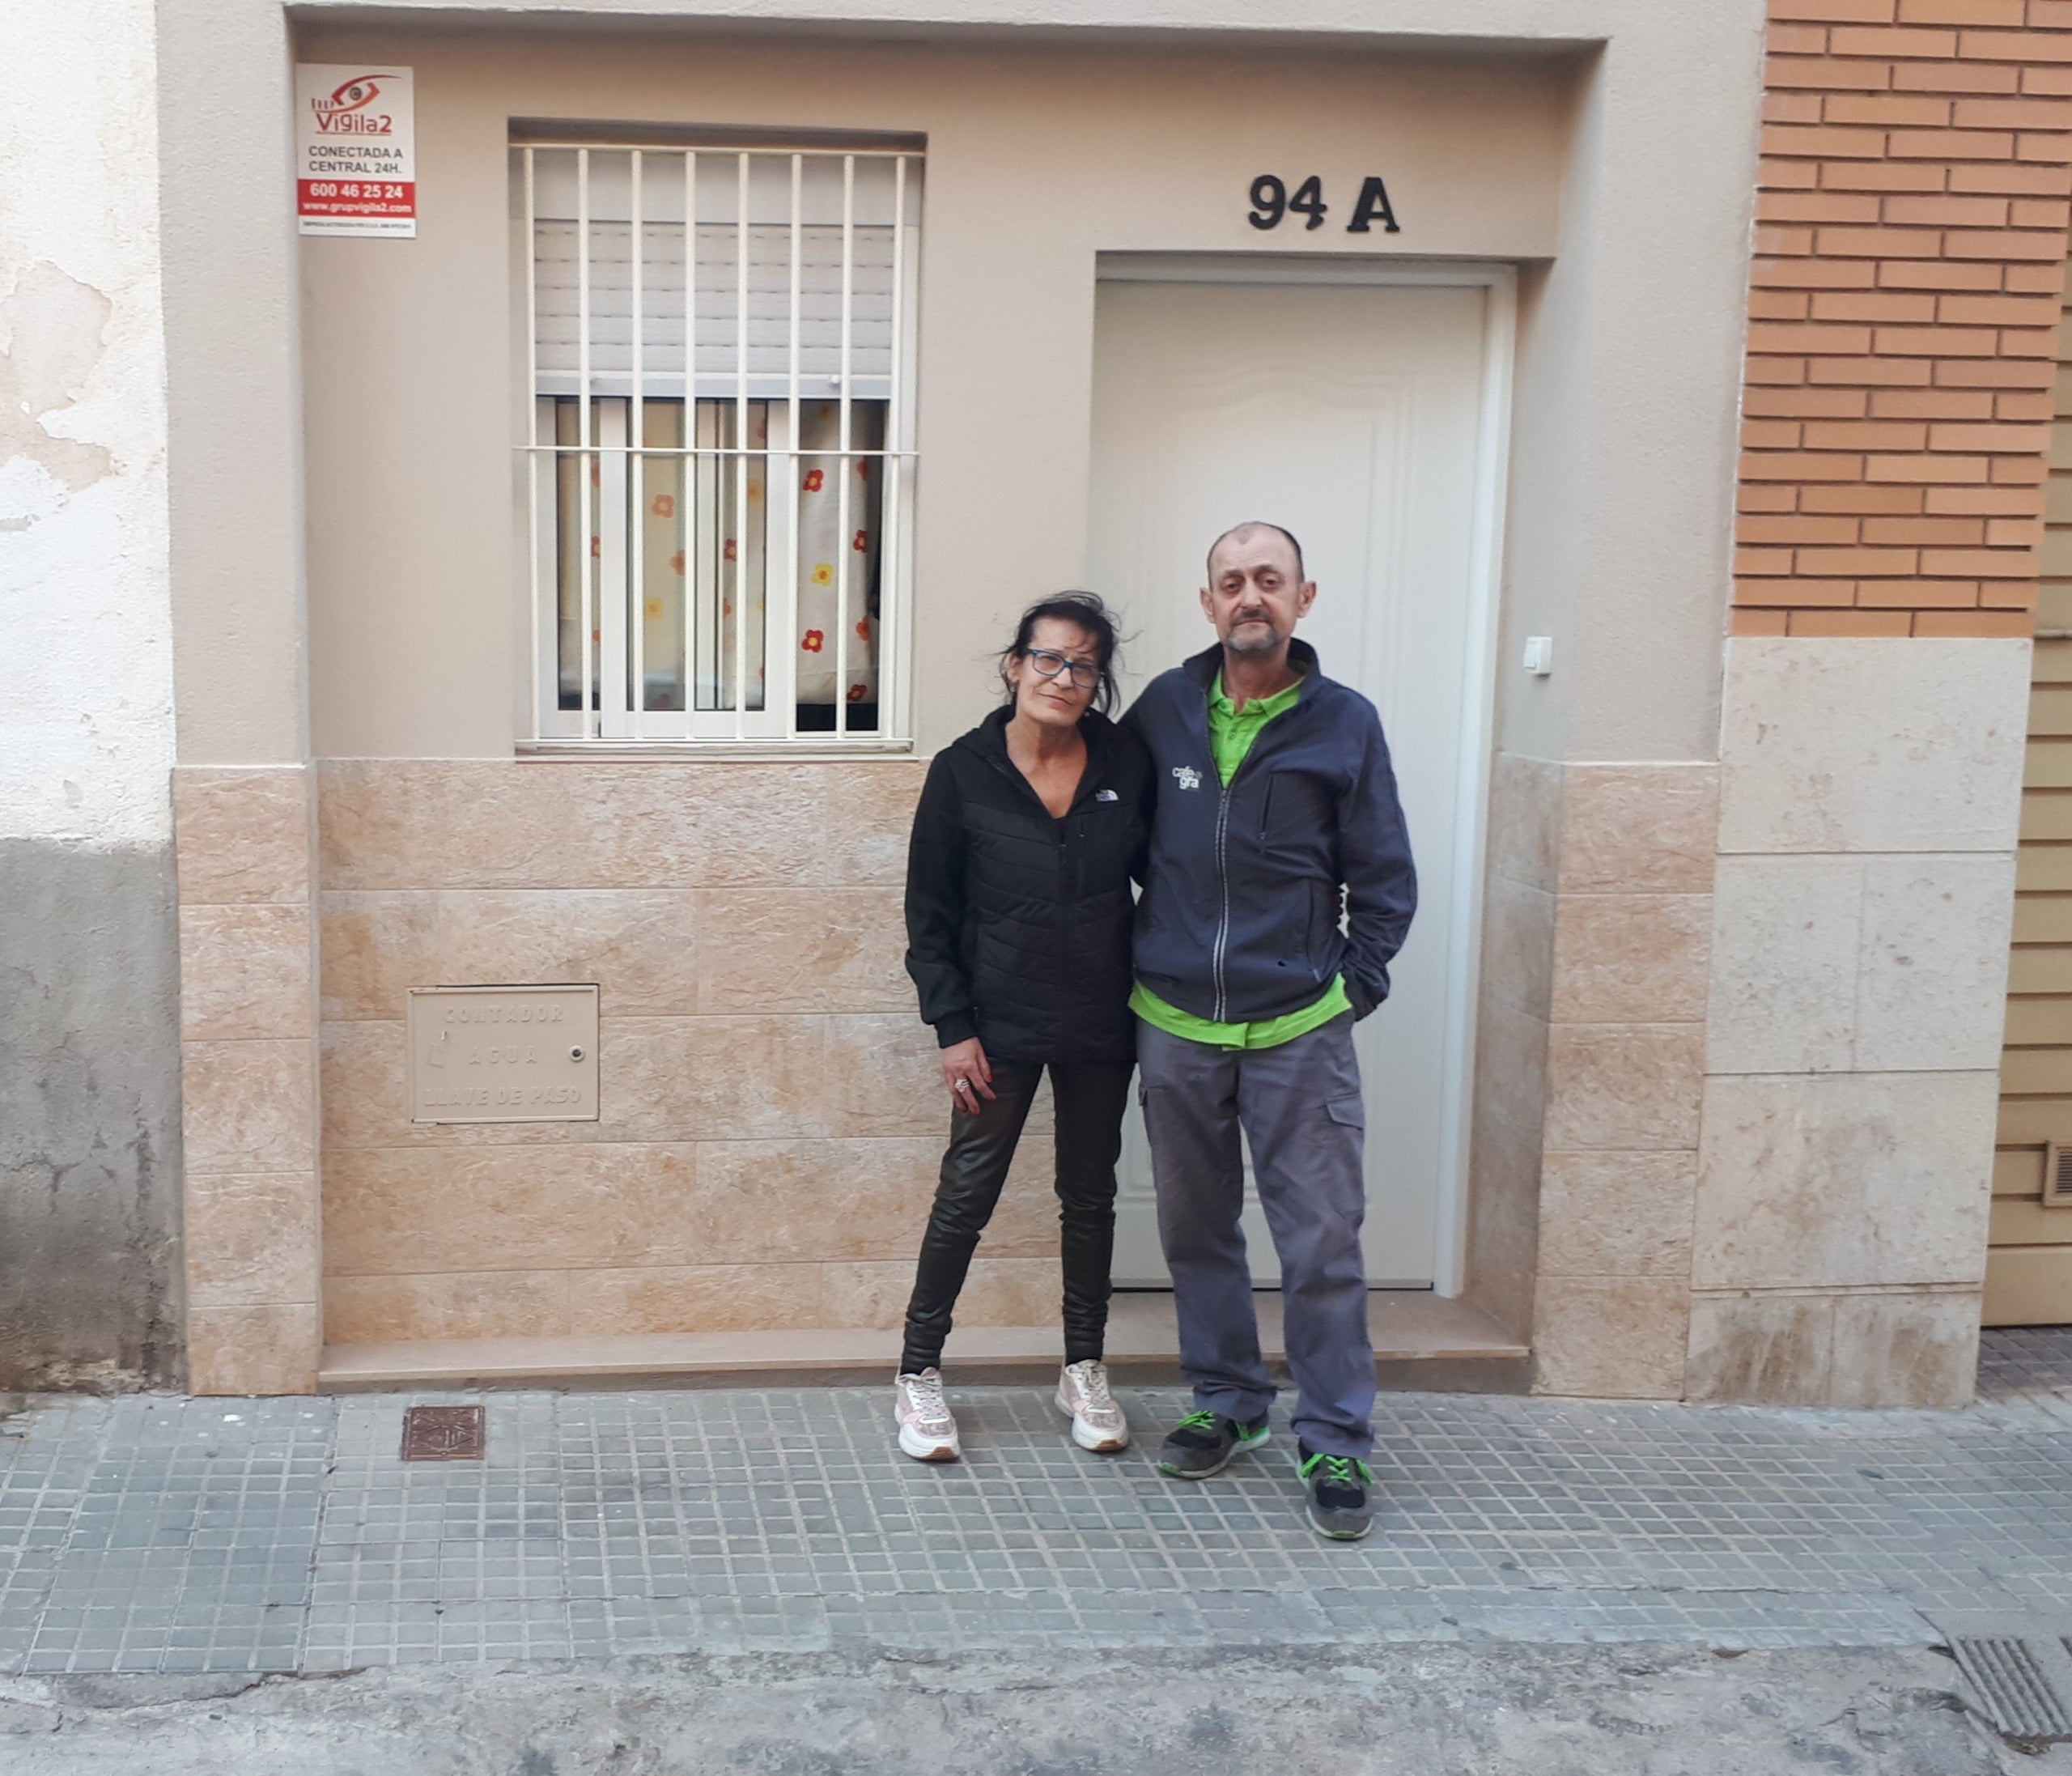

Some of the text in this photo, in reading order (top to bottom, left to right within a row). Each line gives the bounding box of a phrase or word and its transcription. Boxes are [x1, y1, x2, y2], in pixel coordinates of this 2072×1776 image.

[316, 112, 392, 134] Vigila2
[308, 145, 403, 159] CONECTADA A
[308, 161, 402, 174] CENTRAL 24H.
[310, 183, 404, 199] 600 46 25 24
[1248, 174, 1400, 232] 94 A
